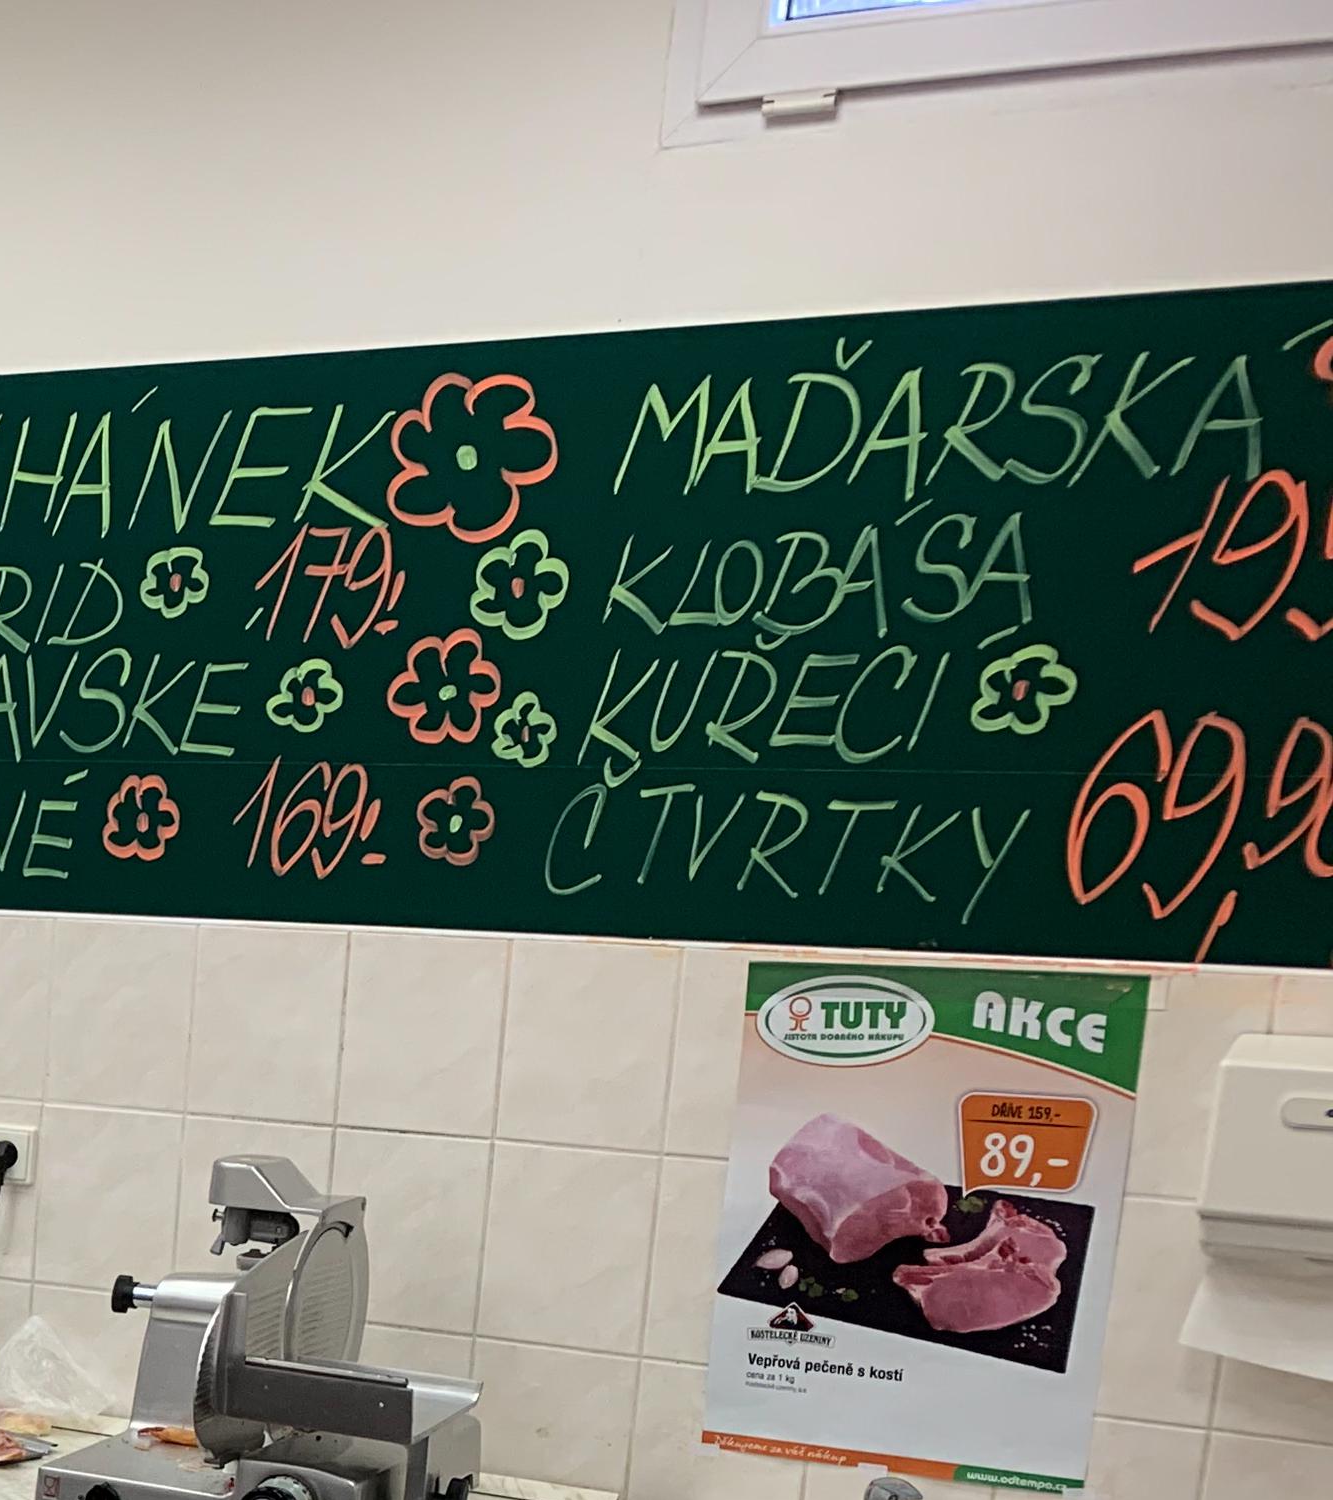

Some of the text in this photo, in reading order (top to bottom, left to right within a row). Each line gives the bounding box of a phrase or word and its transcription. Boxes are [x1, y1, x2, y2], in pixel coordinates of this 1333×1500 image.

[604, 499, 1033, 636] KLOBÁSA
[545, 759, 1029, 924] ČTVRTKY
[821, 1001, 907, 1029] TUTY
[973, 991, 1107, 1054] AKCE
[980, 1133, 1069, 1186] 89,-
[746, 1371, 764, 1380] cena
[748, 1353, 903, 1382] Vepřová pečeně s kostí
